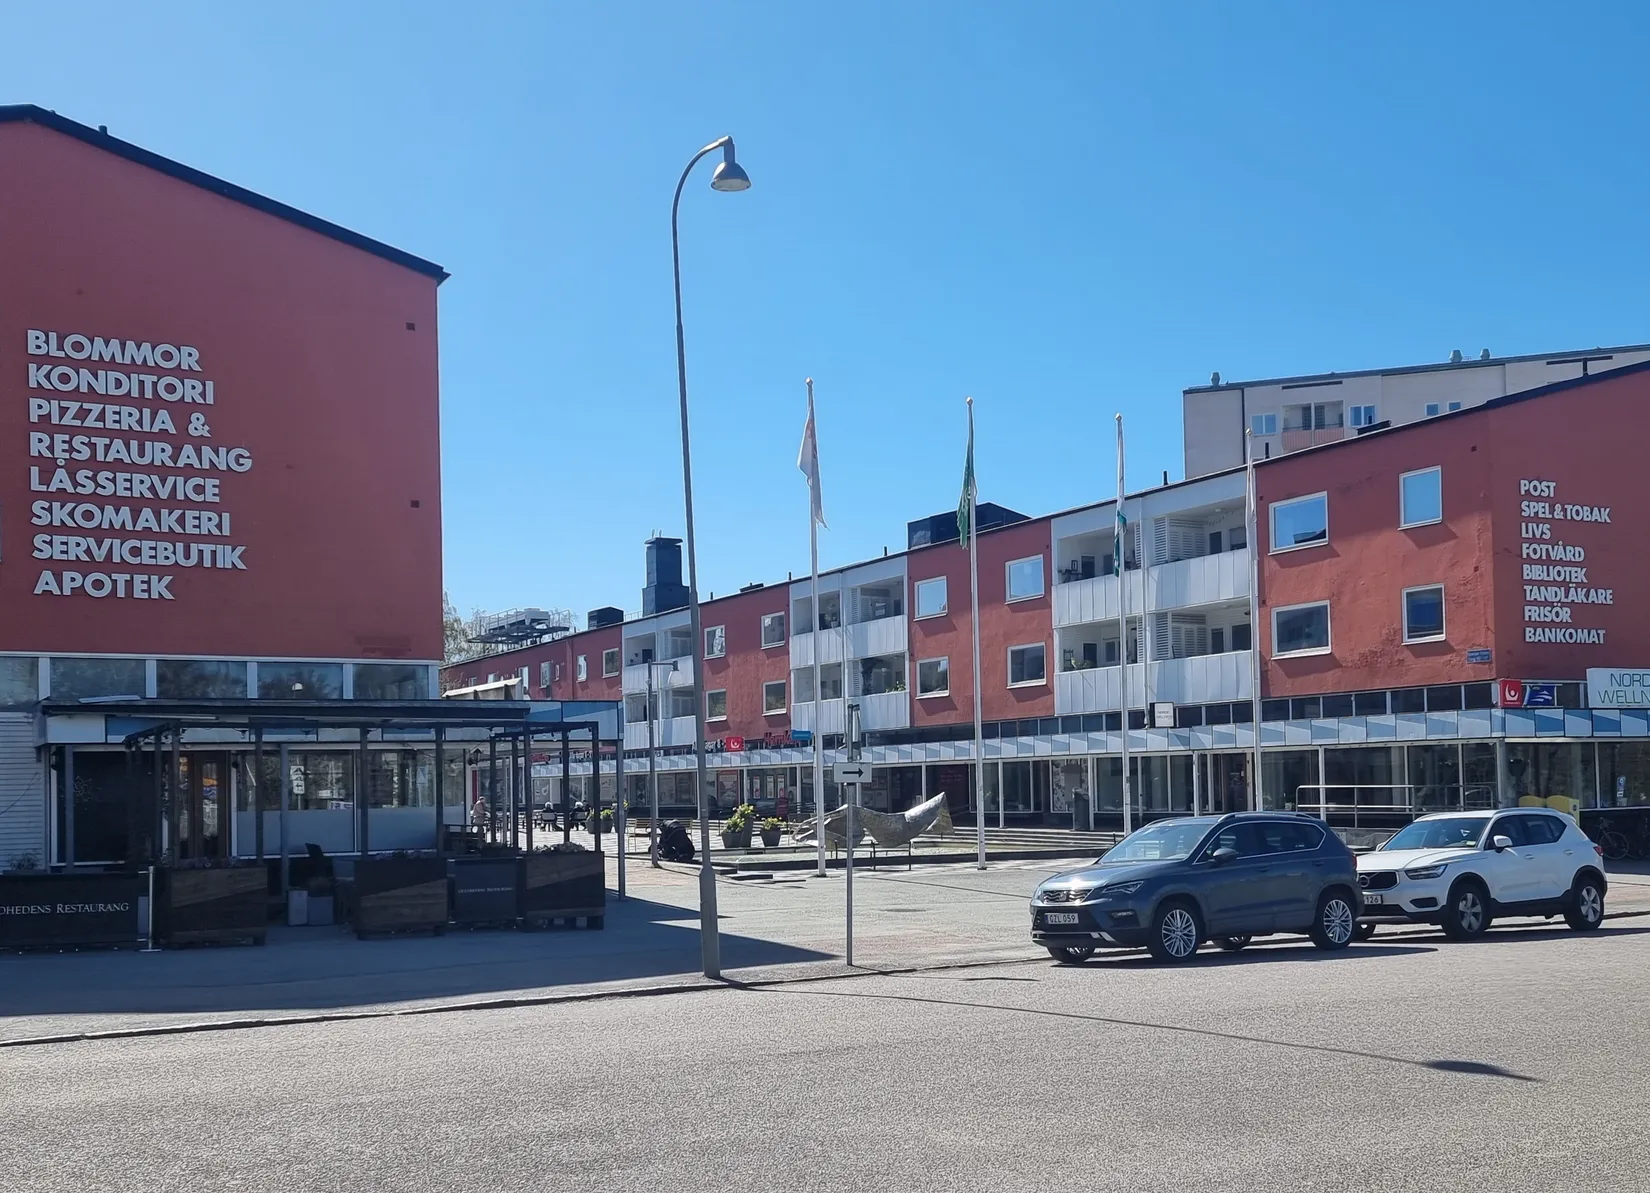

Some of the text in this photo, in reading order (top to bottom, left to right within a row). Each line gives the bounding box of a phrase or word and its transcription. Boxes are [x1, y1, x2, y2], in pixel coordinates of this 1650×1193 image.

[27, 329, 202, 371] BLOMMOR
[28, 363, 214, 404] KONDITORI
[29, 398, 211, 437] PIZZERIA &
[29, 432, 252, 473] RESTAURANG
[30, 458, 220, 502] LÅSSERVICE
[1520, 479, 1556, 498] POST
[31, 500, 230, 536] SKOMAKERI
[1520, 501, 1611, 523] SPEL & TOBAK
[1521, 522, 1551, 540] LIVS
[32, 534, 247, 570] SERVICEBUTIK
[1522, 540, 1585, 562] FOTVÅRD
[1522, 564, 1587, 583] BIBLIOTEK
[33, 570, 175, 600] APOTEK
[1524, 584, 1613, 605] TANDLÄKARE
[1524, 603, 1572, 623] FRISÖR
[1525, 626, 1606, 644] BANKOMAT
[1366, 896, 1379, 904] 126
[1063, 914, 1076, 922] 059
